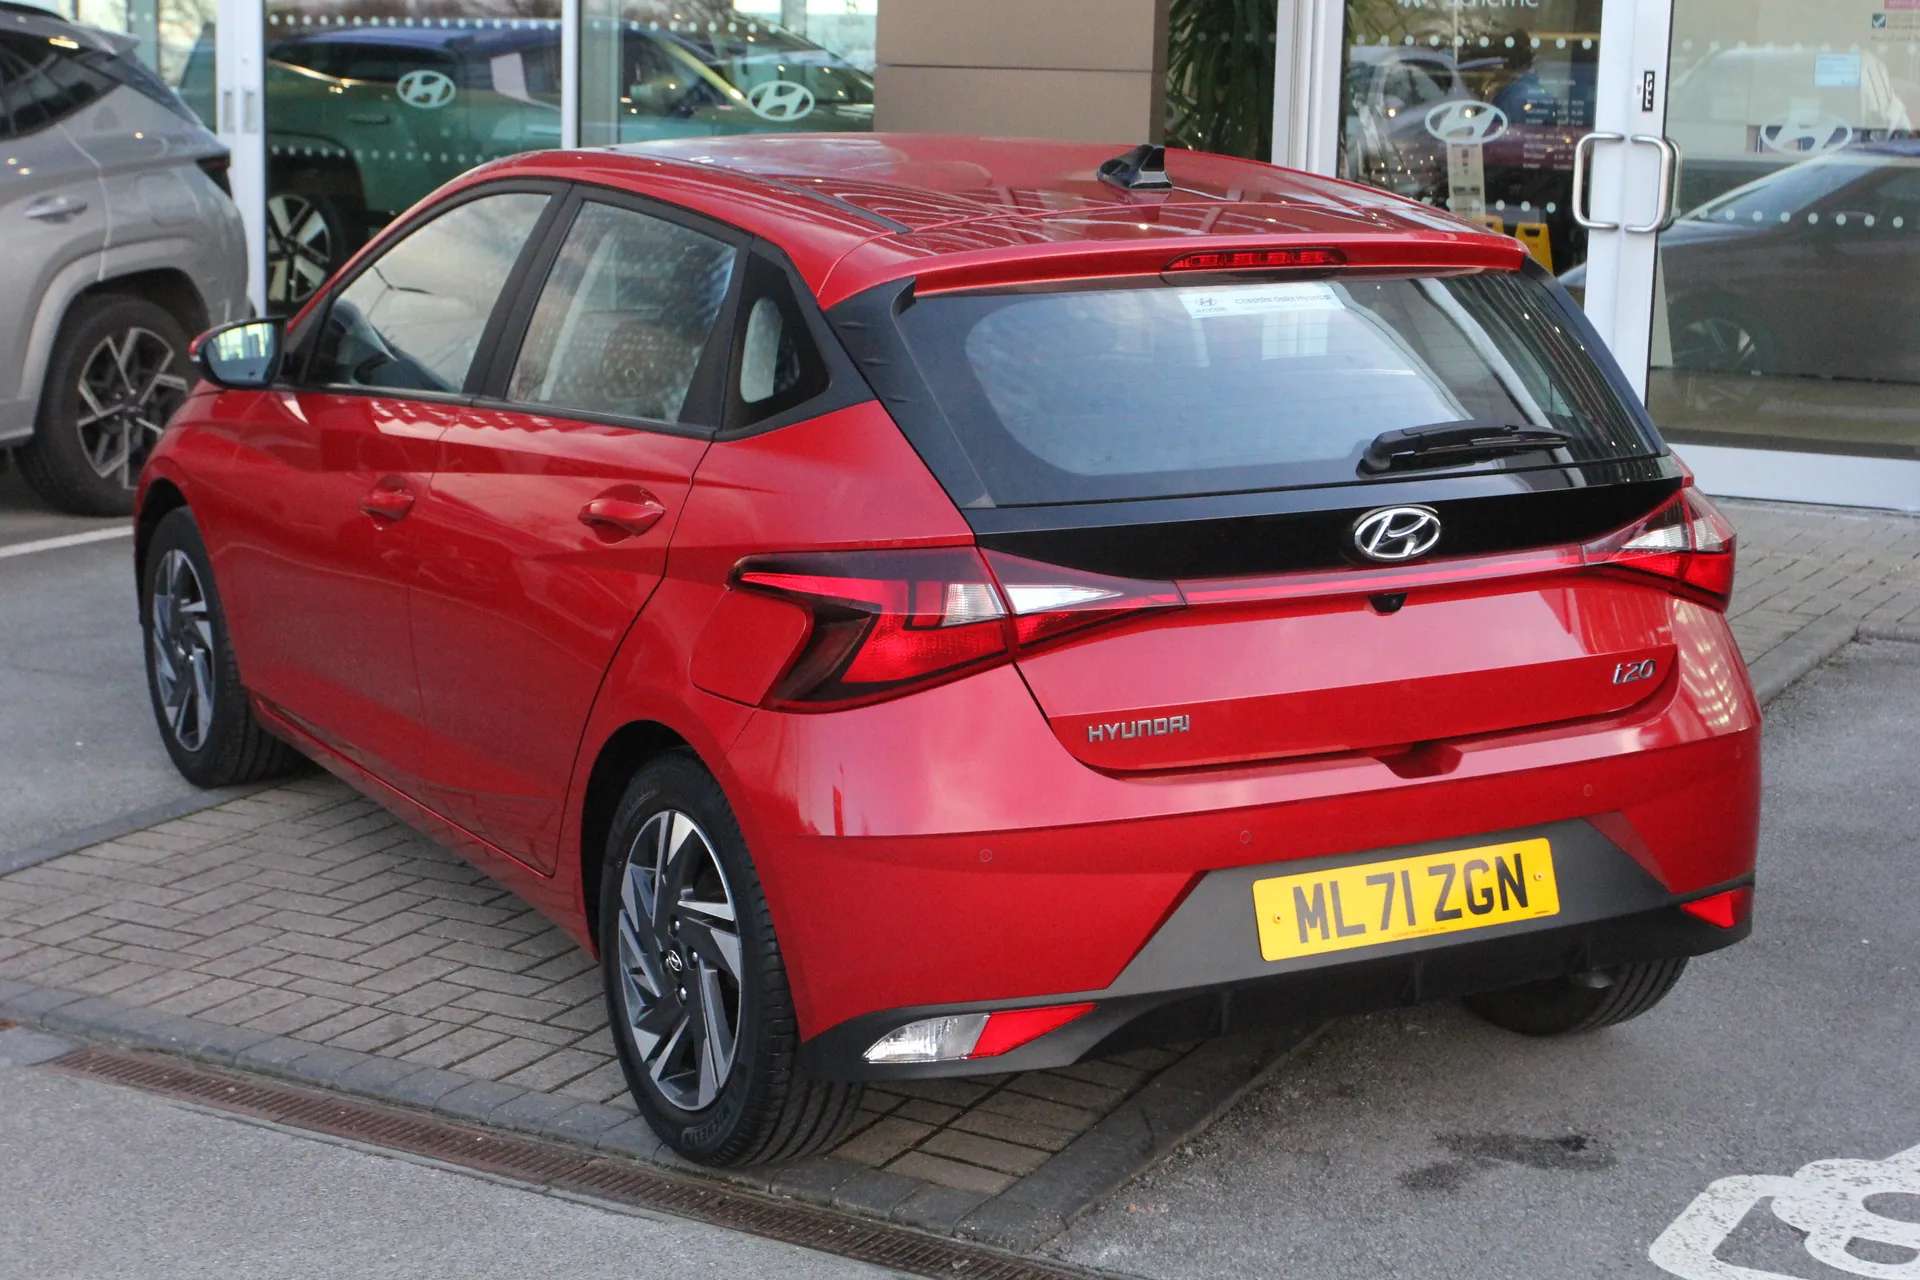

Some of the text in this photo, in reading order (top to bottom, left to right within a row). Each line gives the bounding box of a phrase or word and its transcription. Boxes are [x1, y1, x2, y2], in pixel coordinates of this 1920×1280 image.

[1644, 72, 1654, 108] PULL
[1612, 658, 1657, 685] i20
[1087, 713, 1191, 743] HYUNDAI
[1292, 852, 1529, 944] ML71 ZGN
